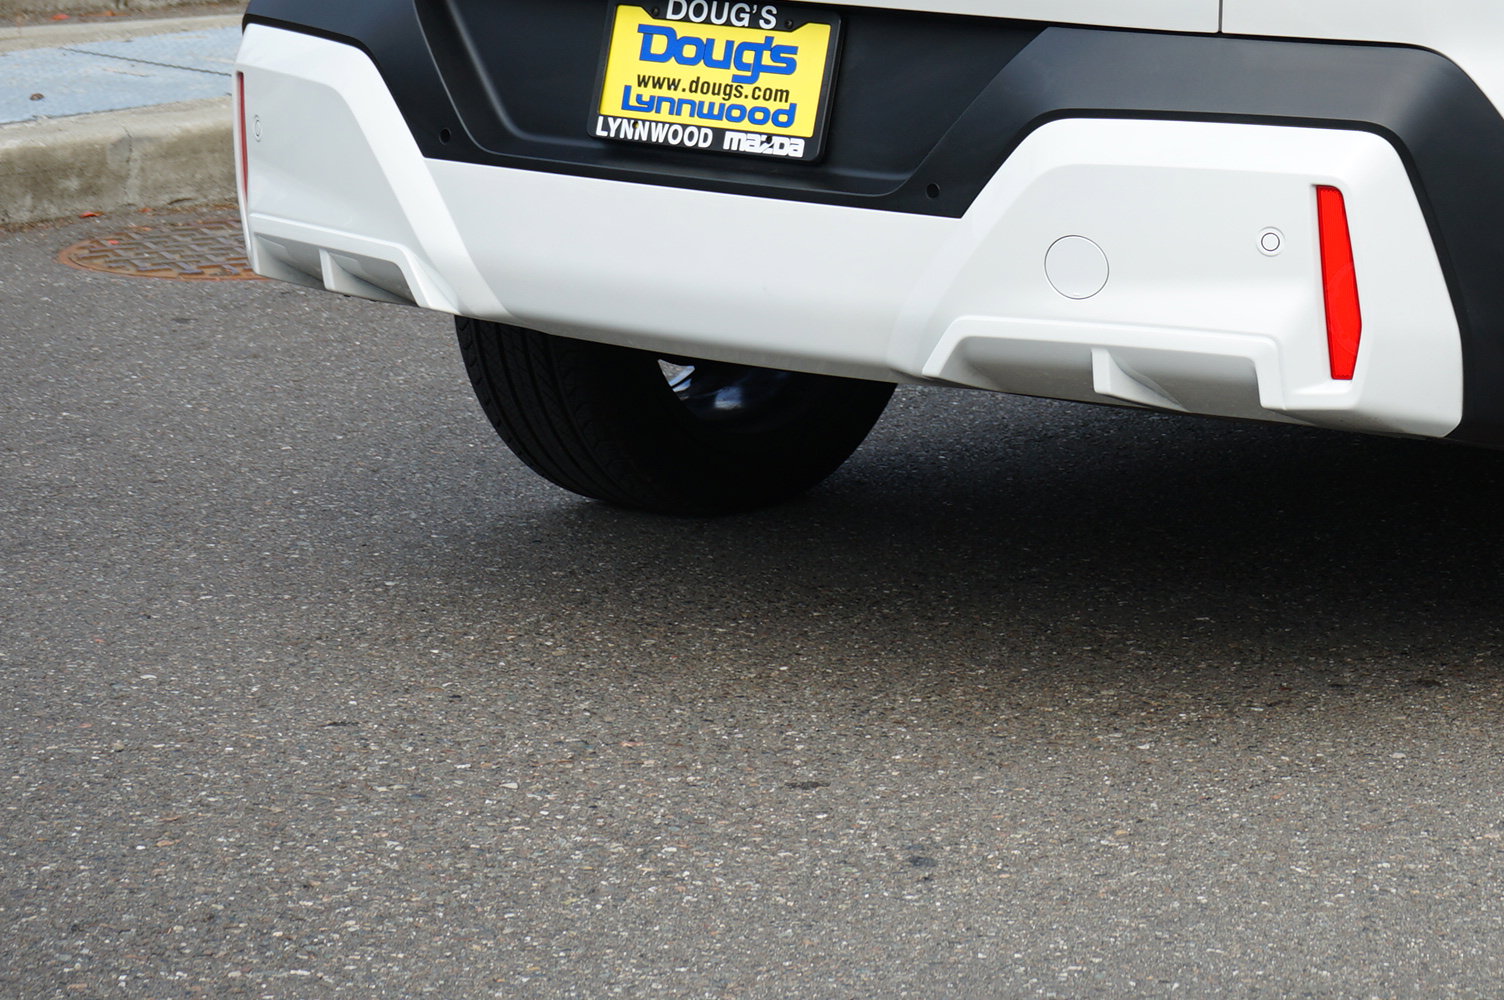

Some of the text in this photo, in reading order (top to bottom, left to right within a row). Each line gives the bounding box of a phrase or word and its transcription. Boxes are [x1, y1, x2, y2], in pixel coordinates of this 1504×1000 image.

[637, 24, 798, 84] Doug's
[621, 85, 797, 128] Lynnwood
[637, 74, 790, 103] www.dougs.com
[596, 116, 713, 148] LYNNWOOD
